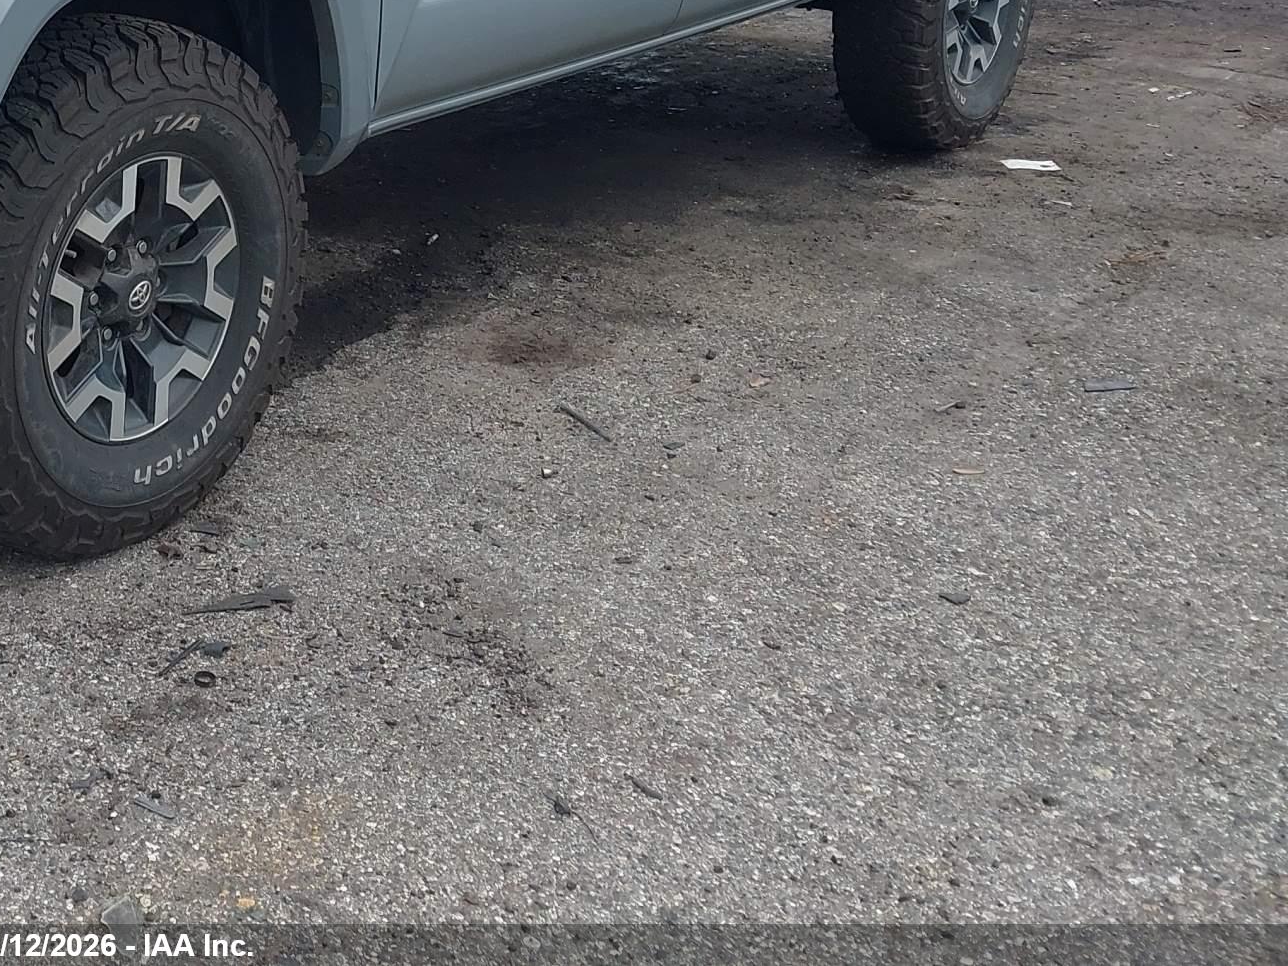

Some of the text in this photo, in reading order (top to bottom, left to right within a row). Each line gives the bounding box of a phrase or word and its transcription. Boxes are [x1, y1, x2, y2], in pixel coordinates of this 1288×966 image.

[25, 111, 203, 355] All-Terrain T/A
[134, 275, 276, 485] BFGoodrich
